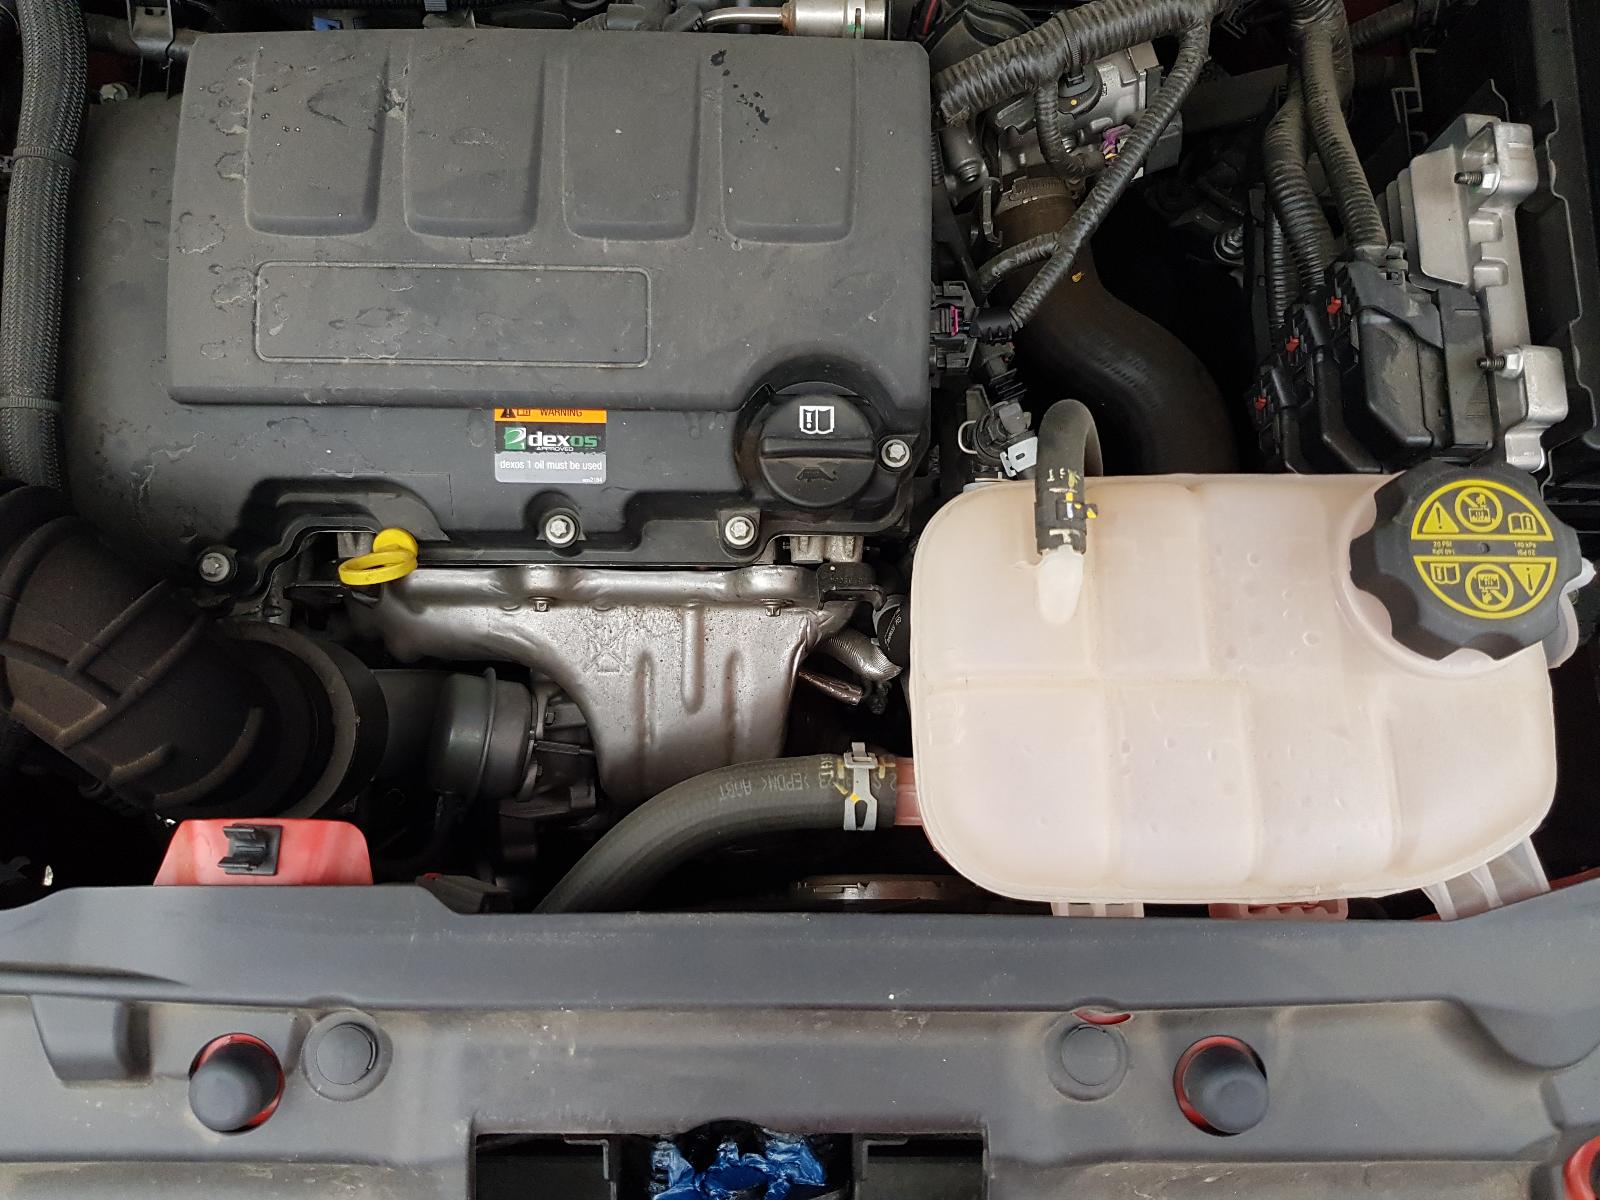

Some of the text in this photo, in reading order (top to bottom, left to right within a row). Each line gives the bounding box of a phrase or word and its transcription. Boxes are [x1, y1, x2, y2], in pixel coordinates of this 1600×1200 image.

[540, 408, 583, 417] WARNING
[528, 431, 598, 447] dexos
[500, 460, 525, 469] dexos
[534, 460, 545, 469] oil
[547, 460, 568, 470] must
[570, 460, 580, 470] be
[582, 461, 602, 471] used
